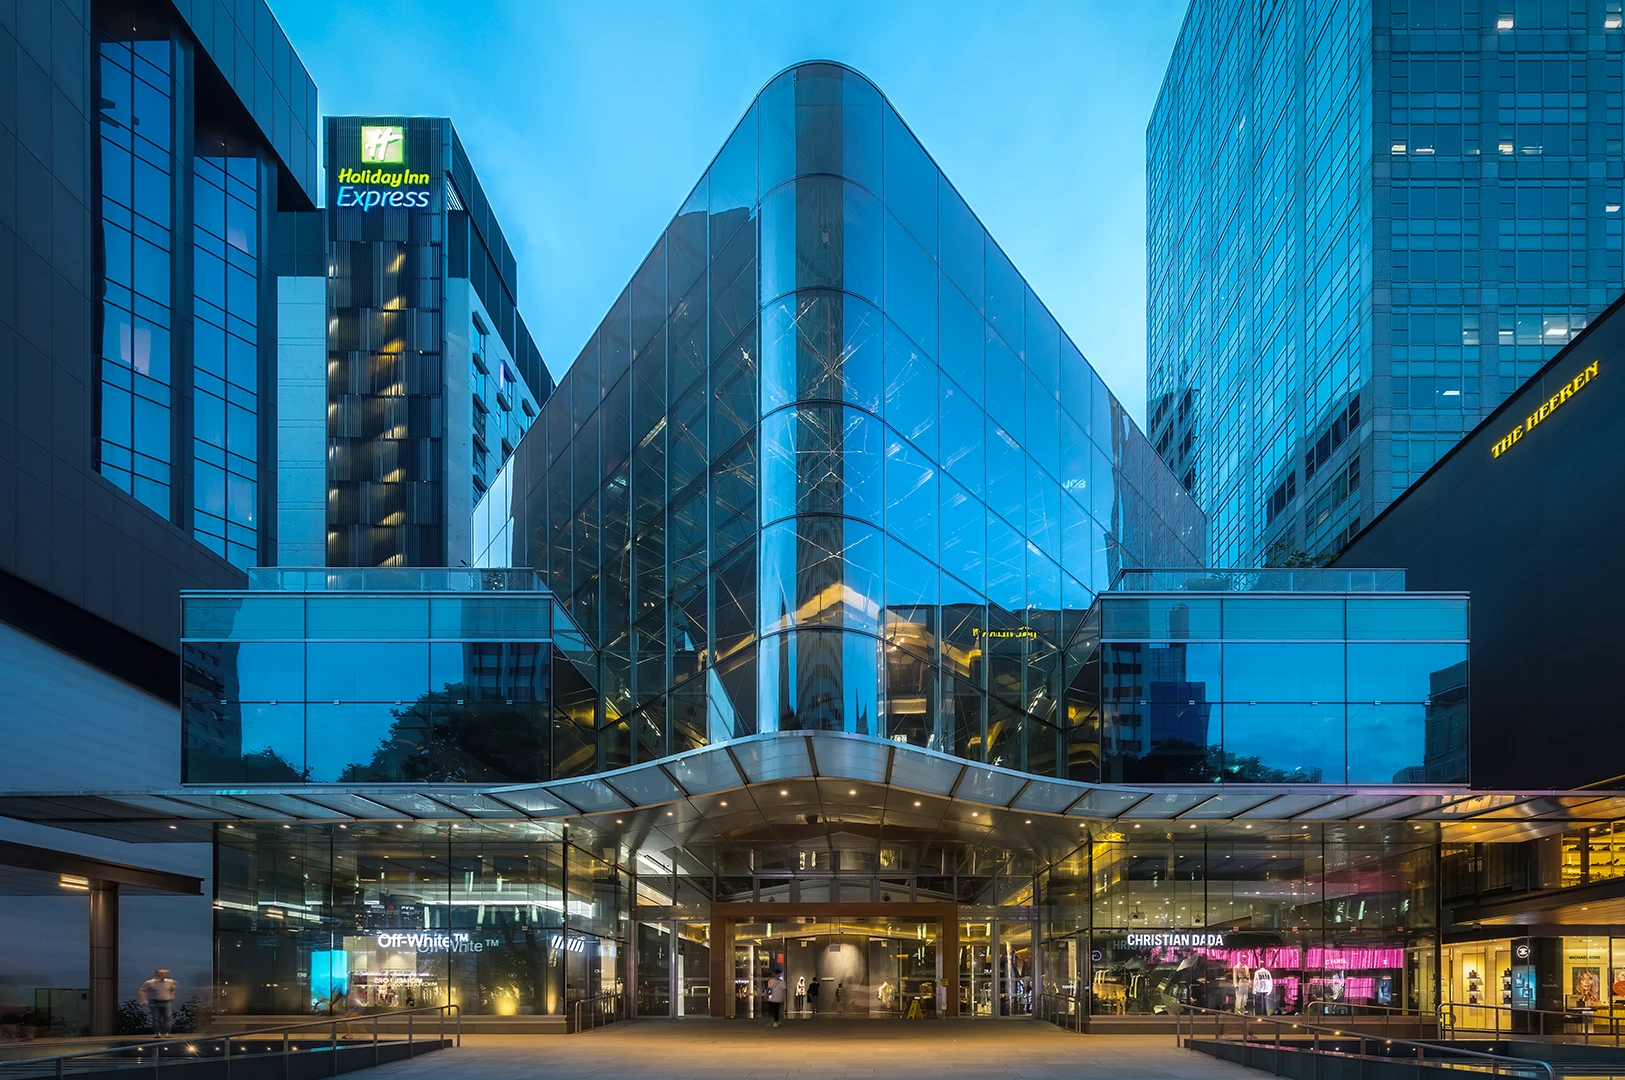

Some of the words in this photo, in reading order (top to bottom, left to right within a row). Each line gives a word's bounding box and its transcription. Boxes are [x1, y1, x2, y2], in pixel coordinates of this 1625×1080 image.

[338, 168, 402, 188] Holiday
[404, 168, 430, 185] Inn
[337, 186, 430, 213] Express
[1491, 425, 1524, 459] THE
[1525, 359, 1601, 432] HEEREN
[1127, 934, 1189, 946] CHRISTIAN
[1192, 934, 1224, 946] DADA
